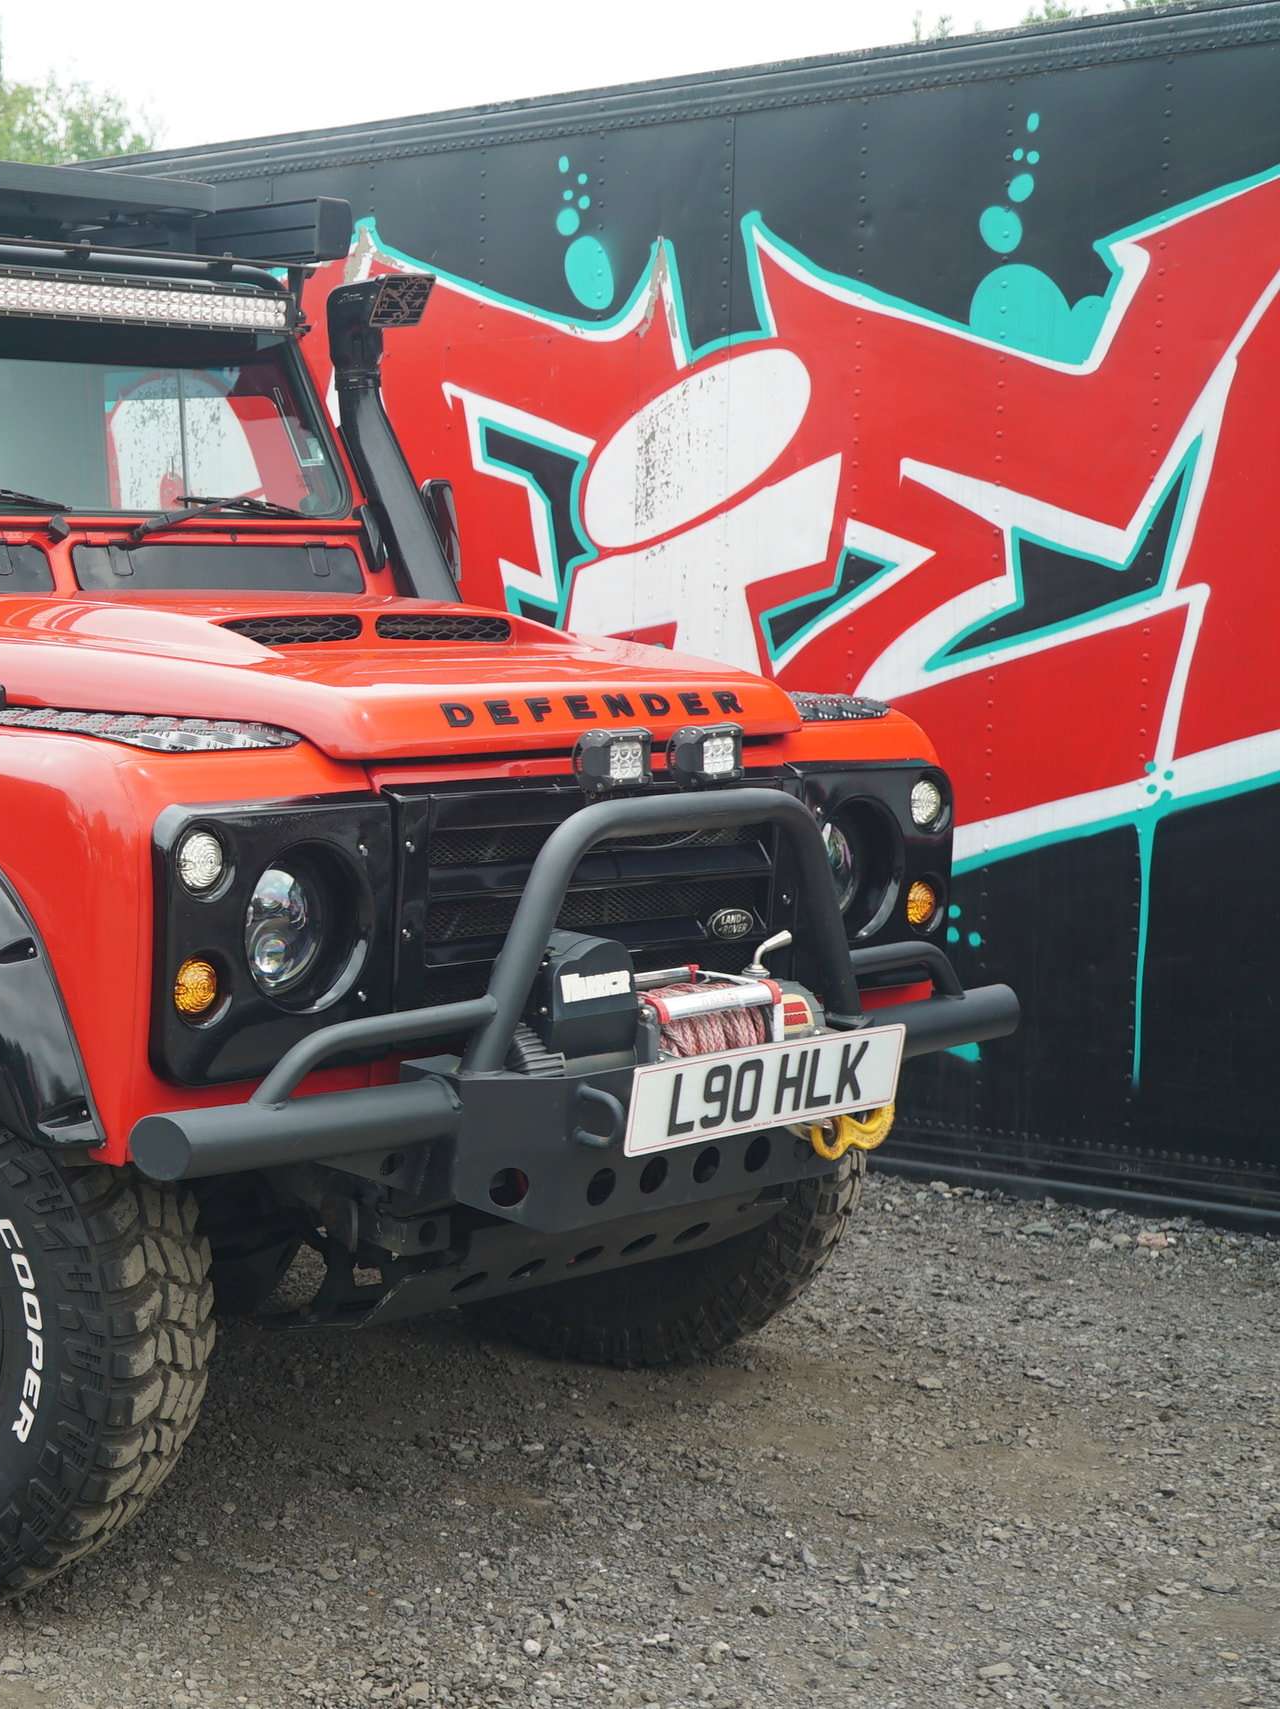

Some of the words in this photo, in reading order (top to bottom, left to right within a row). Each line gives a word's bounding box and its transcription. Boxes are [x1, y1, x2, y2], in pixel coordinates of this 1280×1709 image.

[440, 690, 744, 728] DEFENDER
[667, 1058, 765, 1137] L90
[773, 1040, 870, 1115] HLK
